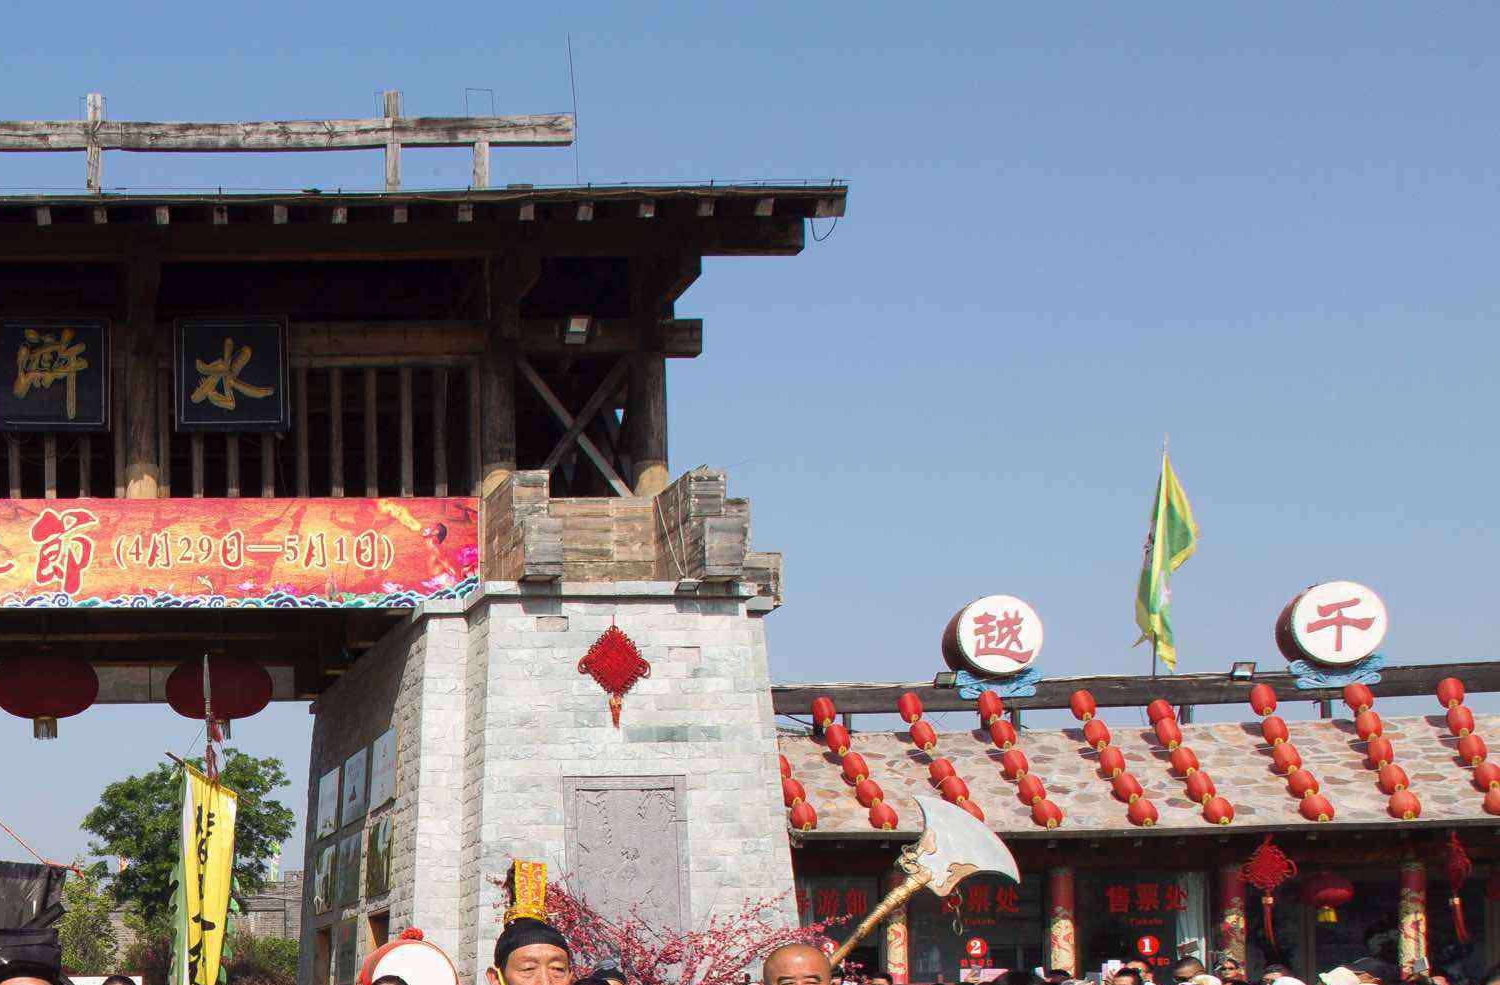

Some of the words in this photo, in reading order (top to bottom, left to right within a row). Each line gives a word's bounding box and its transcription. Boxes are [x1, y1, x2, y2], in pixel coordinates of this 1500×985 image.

[973, 610, 1034, 663] 越
[1305, 597, 1375, 651] 千
[1105, 883, 1188, 913] 售票处
